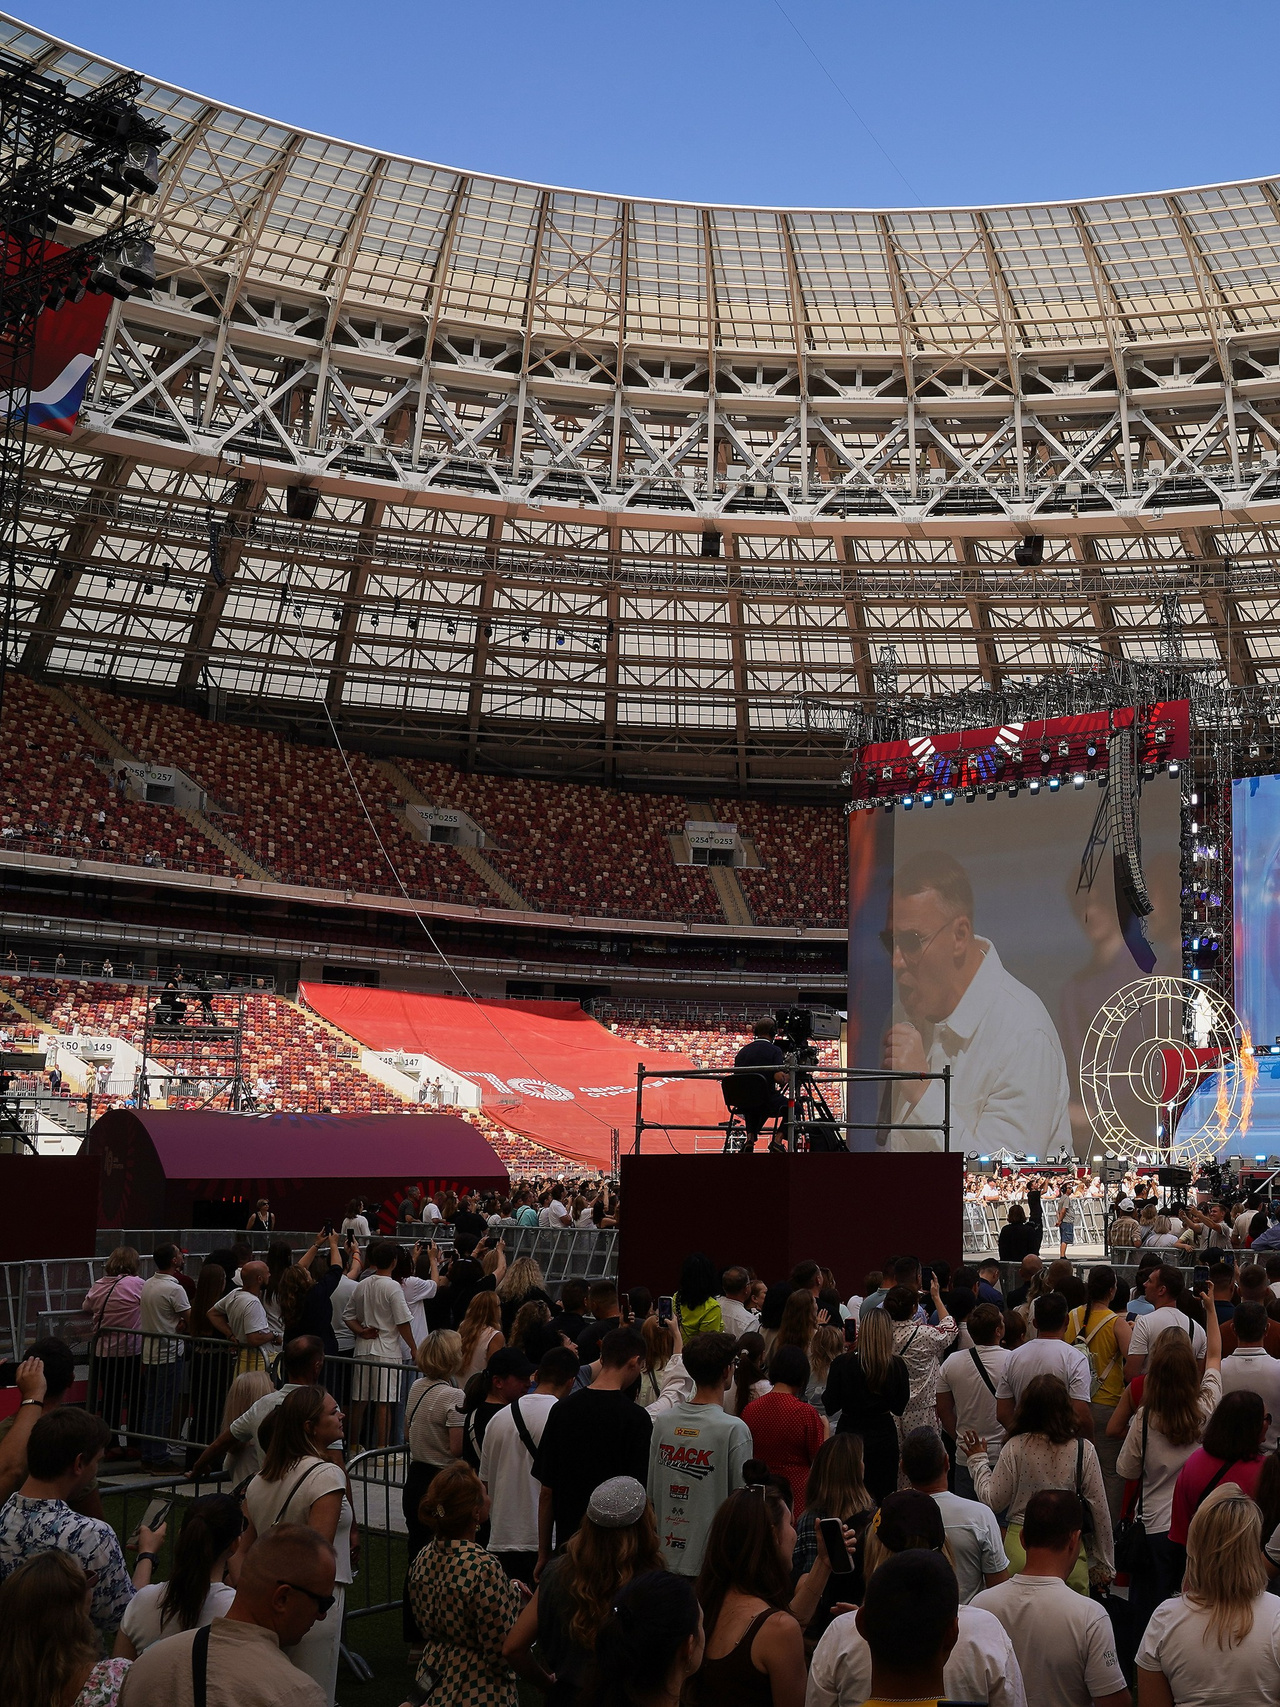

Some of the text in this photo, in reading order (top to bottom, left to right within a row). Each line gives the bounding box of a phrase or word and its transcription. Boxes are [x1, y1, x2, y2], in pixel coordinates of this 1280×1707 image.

[156, 772, 173, 782] 257
[419, 811, 458, 823] 256 255
[695, 836, 709, 844] 254
[93, 1043, 112, 1052] 149
[404, 1058, 419, 1066] 147
